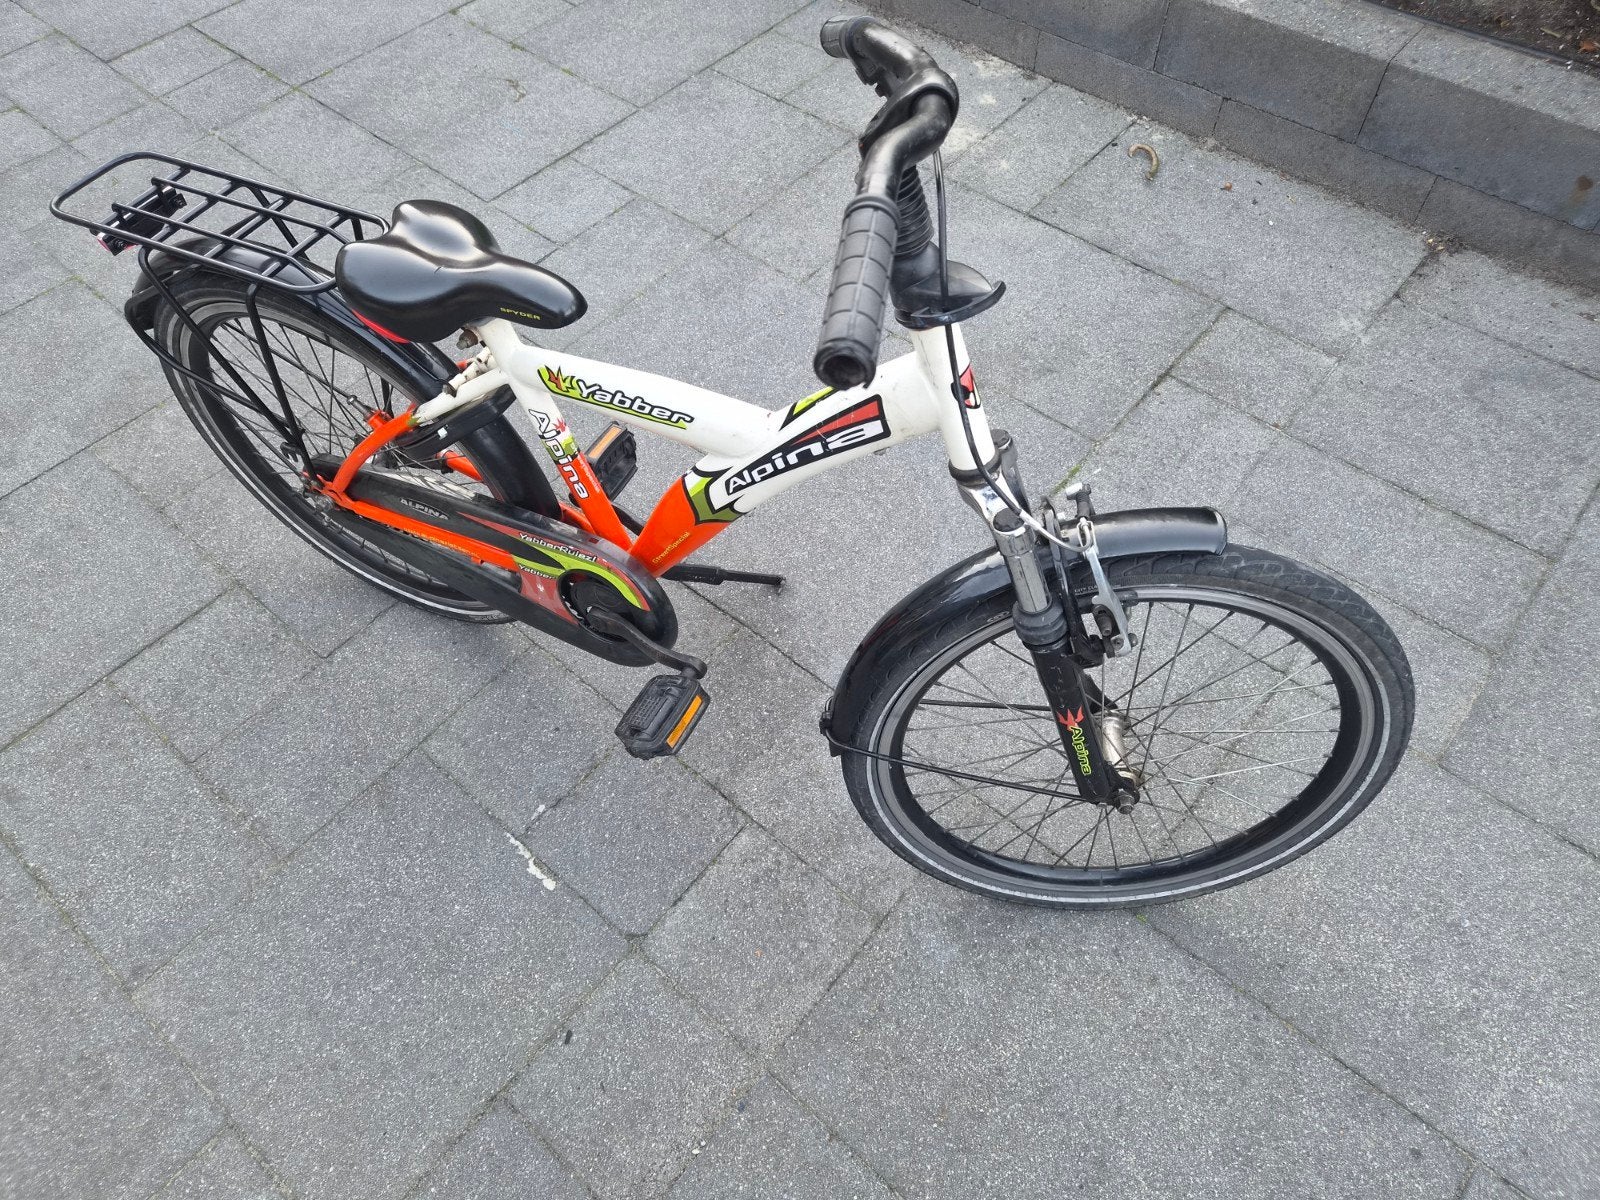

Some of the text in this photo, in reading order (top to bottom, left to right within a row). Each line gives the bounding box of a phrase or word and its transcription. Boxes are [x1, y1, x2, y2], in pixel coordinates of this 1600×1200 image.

[500, 307, 541, 320] SPYDER
[576, 379, 694, 424] Yabber
[528, 408, 589, 499] Alpina
[729, 419, 884, 494] Alpina
[400, 498, 449, 520] ALPINA
[1070, 725, 1092, 776] Alpina
